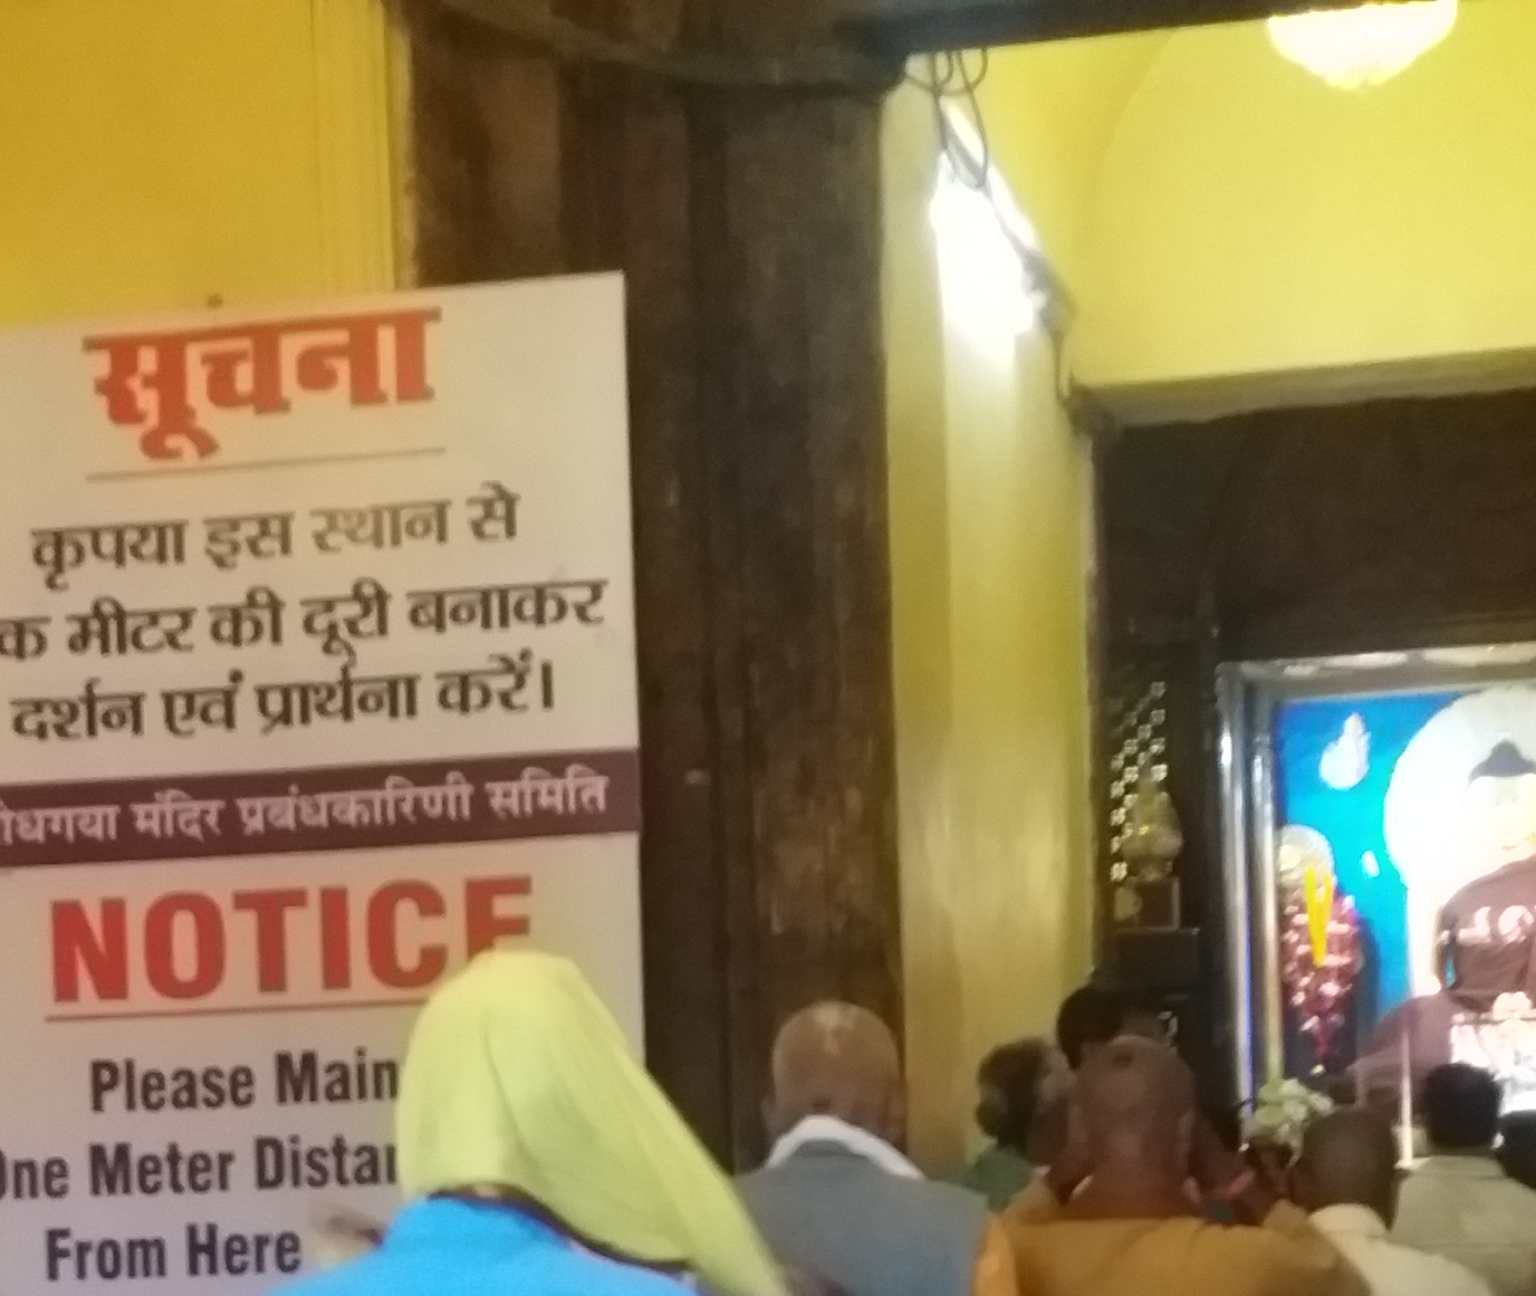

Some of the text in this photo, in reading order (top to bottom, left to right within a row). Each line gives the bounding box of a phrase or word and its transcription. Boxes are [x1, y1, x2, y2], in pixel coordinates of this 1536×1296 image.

[83, 307, 441, 460] सूचना
[30, 481, 520, 590] कृपया इस स्थान से
[65, 598, 197, 657] मीटर
[210, 587, 284, 647] की
[302, 578, 390, 657] दूरी
[407, 579, 608, 633] बनाकर
[11, 679, 144, 740] दर्शन
[162, 668, 244, 736] एवं
[257, 655, 418, 735] प्रार्थना
[133, 788, 225, 841] मंदिर
[237, 771, 471, 837] प्रबंधकारिणी
[485, 764, 609, 818] समिति
[49, 877, 532, 1002] NOTICE
[90, 1059, 254, 1114] Please
[89, 1143, 234, 1197] Meter
[45, 1224, 301, 1282] From Here
